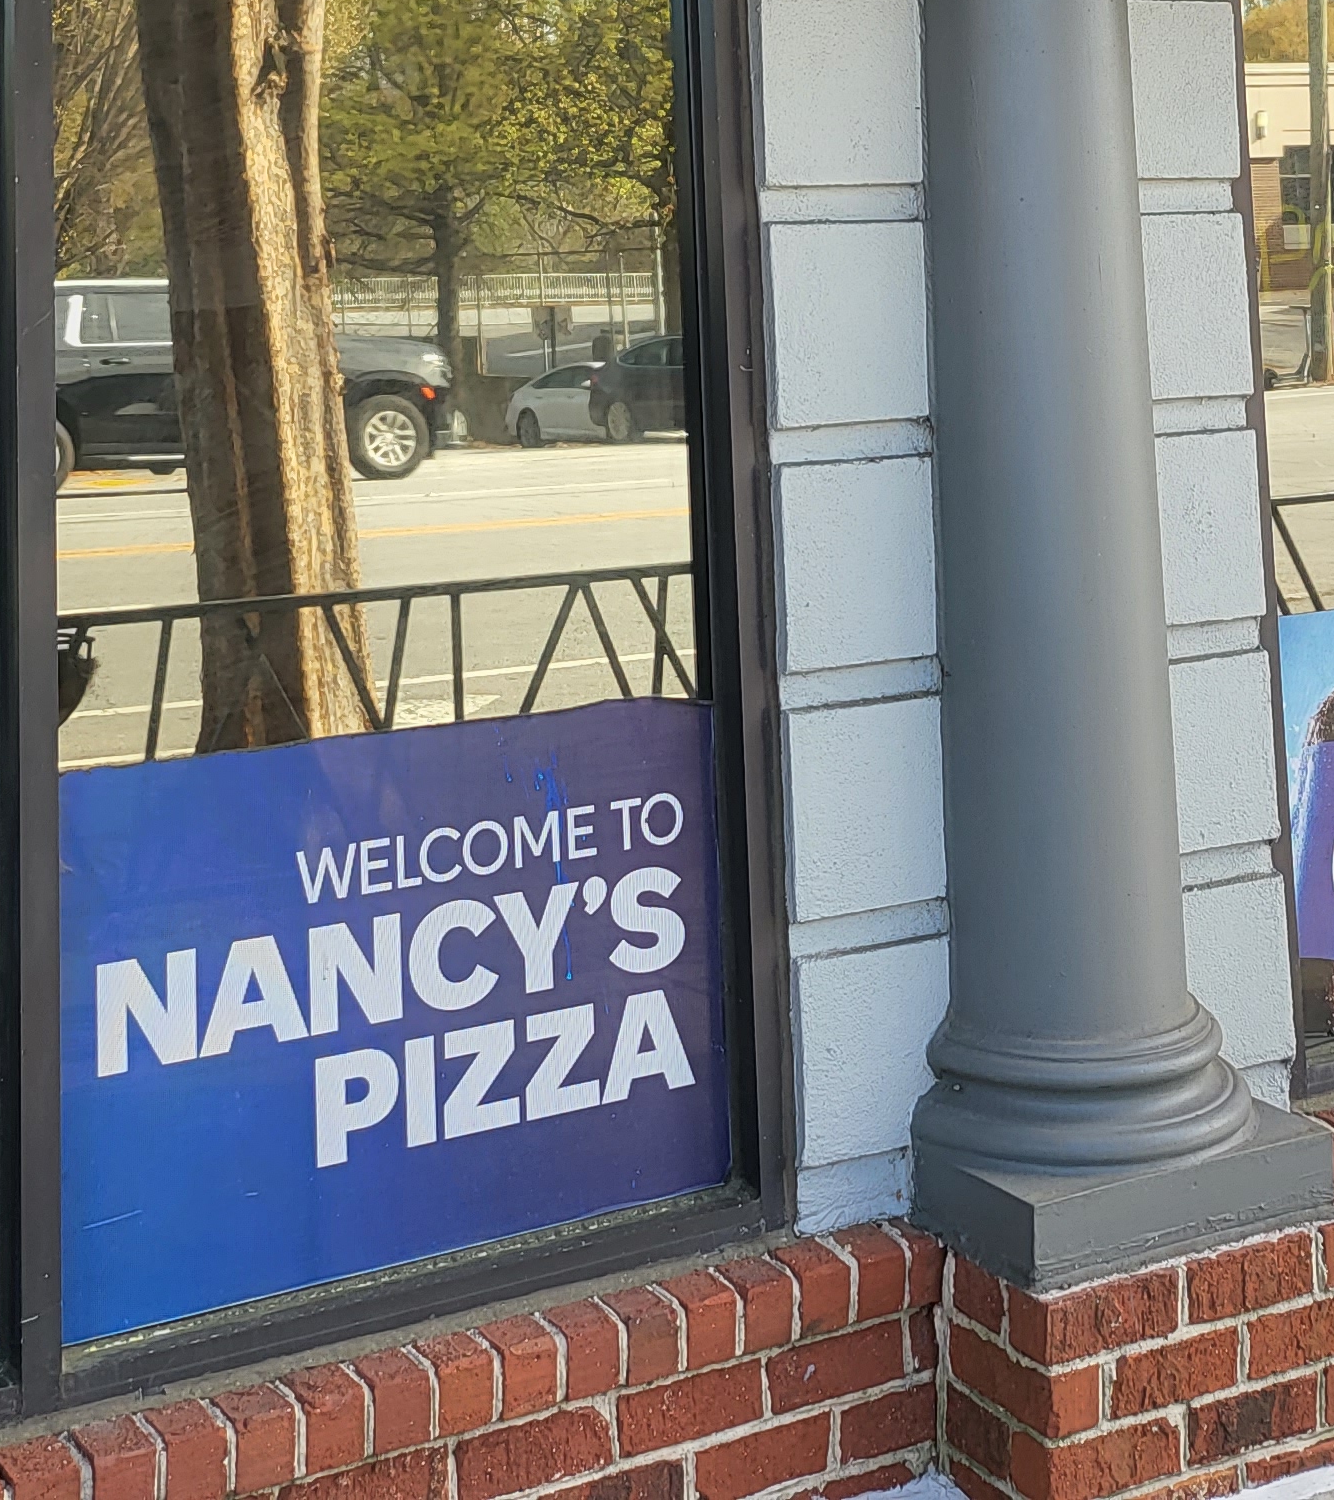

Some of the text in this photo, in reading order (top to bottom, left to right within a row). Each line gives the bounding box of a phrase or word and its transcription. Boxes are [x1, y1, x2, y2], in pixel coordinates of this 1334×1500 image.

[296, 792, 685, 904] WELCOME TO
[96, 866, 687, 1078] NANCY'S
[315, 989, 696, 1169] PIZZA
